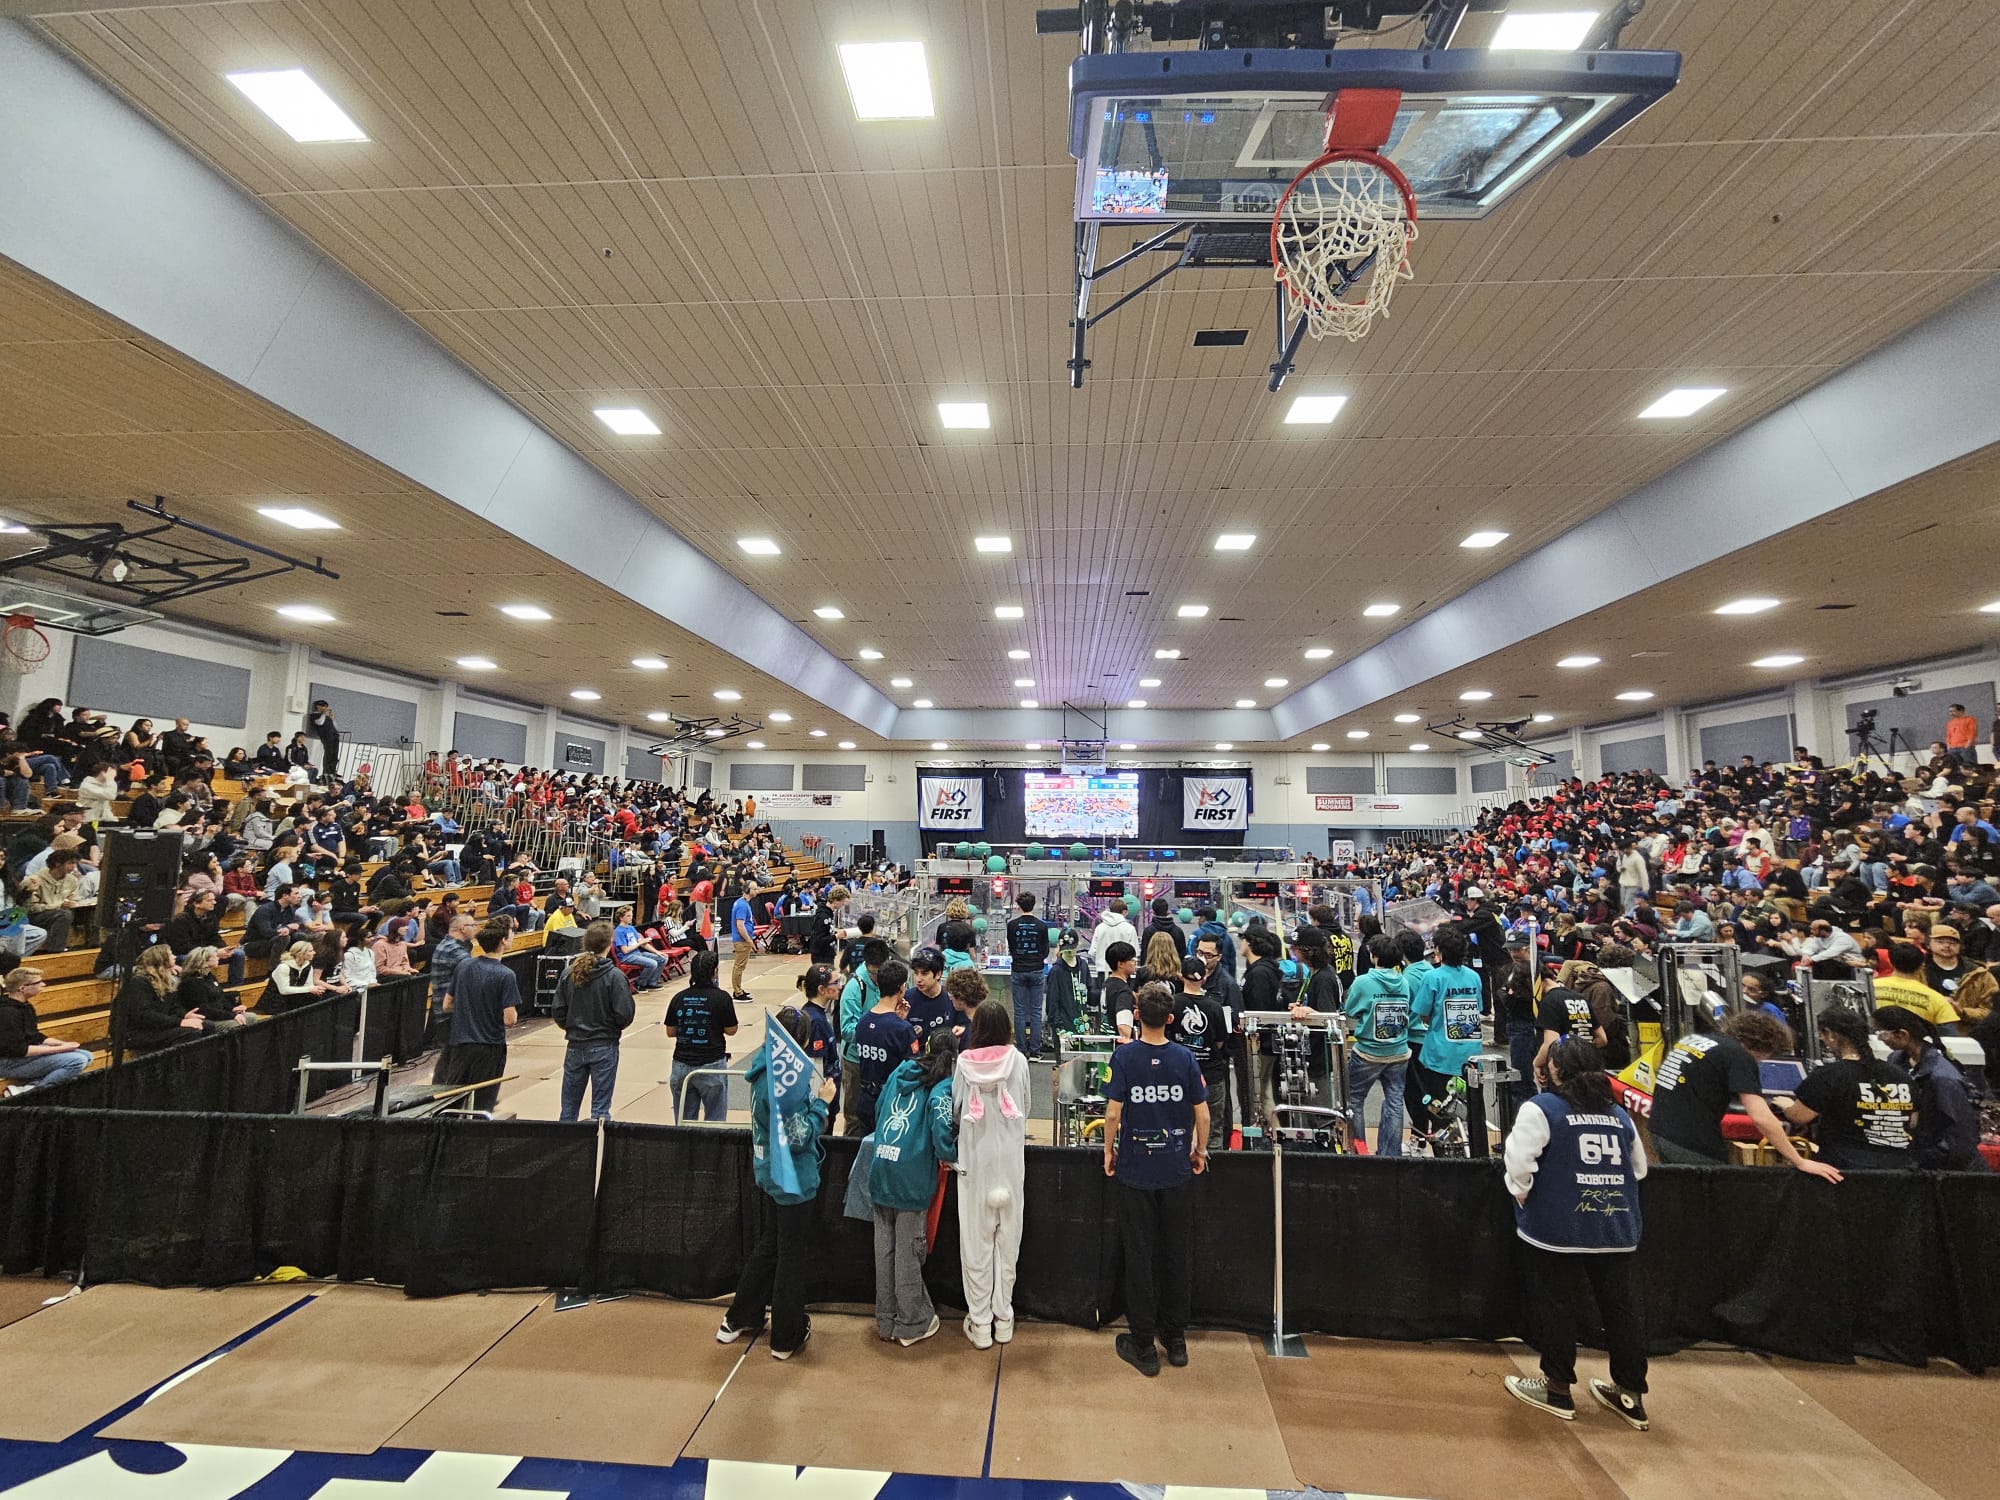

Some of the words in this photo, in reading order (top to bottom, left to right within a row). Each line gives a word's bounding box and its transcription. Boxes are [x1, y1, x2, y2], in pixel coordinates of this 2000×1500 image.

[931, 808, 972, 820] FIRST
[1194, 808, 1236, 820] FIRST
[1446, 987, 1477, 997] JAMES
[1447, 1003, 1478, 1011] REEFSCAP
[1130, 1084, 1184, 1103] 8859
[1858, 1082, 1912, 1104] 528
[1623, 1089, 1652, 1119] 572
[1566, 1112, 1624, 1129] HANNIBAL
[1579, 1133, 1622, 1165] 64
[1575, 1173, 1625, 1185] ROBOTICS
